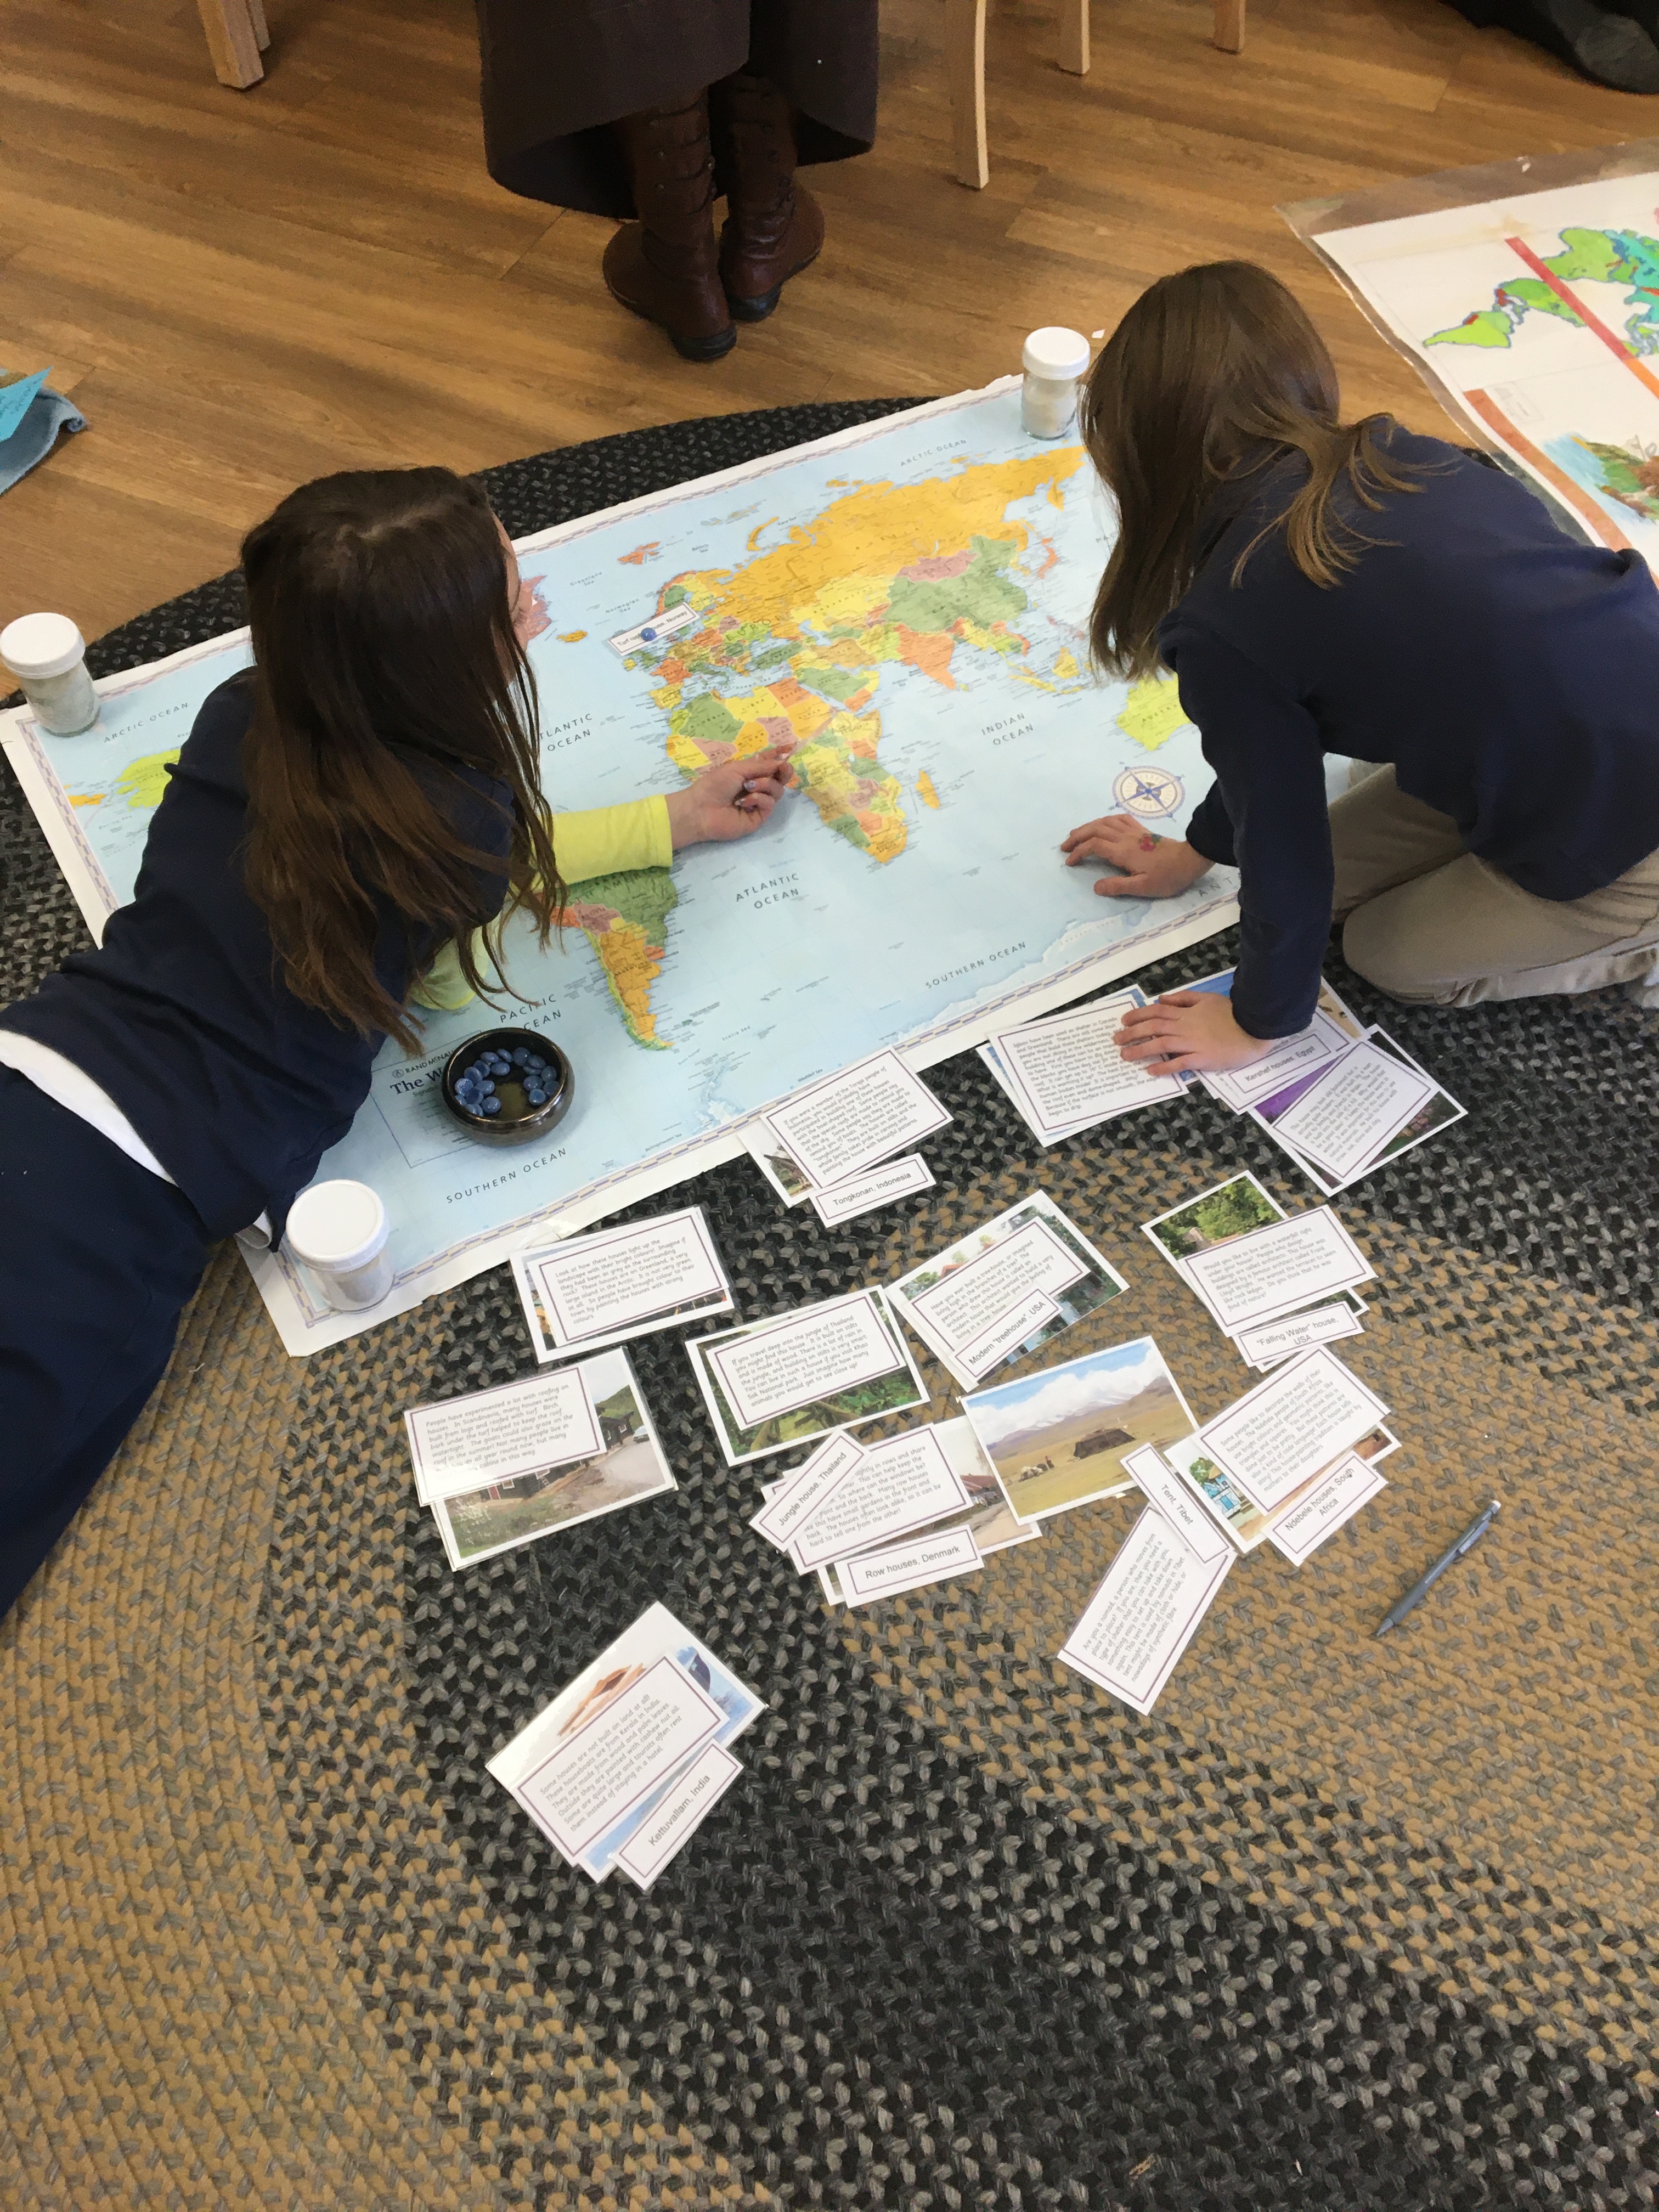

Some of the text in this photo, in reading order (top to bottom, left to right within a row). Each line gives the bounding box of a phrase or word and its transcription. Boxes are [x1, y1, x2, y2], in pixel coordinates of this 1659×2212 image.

[900, 439, 967, 467] ARCTIC OCEAN
[665, 611, 687, 623] Norway
[104, 702, 188, 743] ARCTIC OCEAN
[539, 713, 592, 740] TLANTIC
[981, 713, 1025, 736] INDIAN
[992, 723, 1034, 746] OCEAN
[547, 729, 591, 752] OCEAN
[736, 873, 799, 902] ATLANTIC
[754, 888, 799, 909] OCEAN
[926, 941, 1026, 989] SOUTHERN OCEAN
[500, 994, 556, 1023] PACIIC
[523, 1009, 561, 1030] CEAN
[1294, 1045, 1316, 1058] Egypt
[405, 1062, 427, 1074] RAND
[390, 1077, 425, 1094] The
[446, 1148, 567, 1204] SOUTHERN OCEAN
[832, 1173, 911, 1205] Tongkonan, Indonesia
[555, 1268, 569, 1278] Look
[591, 1257, 607, 1265] these
[607, 1250, 627, 1260] houses
[627, 1245, 641, 1254] light
[930, 1300, 944, 1310] Have
[944, 1294, 954, 1304] you
[953, 1286, 964, 1295] ever
[963, 1278, 977, 1288] built
[980, 1259, 1007, 1277] tree-house,
[1011, 1239, 1034, 1256] imagined
[968, 1343, 995, 1364] Modern
[1028, 1301, 1046, 1314] USA
[1312, 1317, 1339, 1328] house,
[731, 1358, 737, 1367] If
[737, 1355, 749, 1365] you
[749, 1347, 766, 1358] travel
[767, 1343, 781, 1352] deep
[804, 1328, 822, 1339] jungle
[822, 1323, 830, 1331] of
[829, 1314, 854, 1328] Thailand
[1293, 1334, 1313, 1345] USA
[425, 1418, 446, 1427] People
[464, 1400, 505, 1417] experimented
[522, 1392, 536, 1401] with
[538, 1386, 560, 1396] roofing
[1220, 1435, 1234, 1447] Some
[1234, 1423, 1250, 1438] people
[1248, 1416, 1259, 1424] like
[1264, 1396, 1284, 1413] decorate
[1292, 1381, 1305, 1392] walls
[1304, 1375, 1312, 1384] of
[1309, 1368, 1321, 1379] their
[778, 1452, 847, 1526] Jungle house, Thailand
[1161, 1483, 1193, 1525] Tent, Tibet
[1284, 1468, 1355, 1531] Ndebele houses, South
[1319, 1498, 1339, 1516] Africa
[809, 1537, 825, 1548] hard
[833, 1530, 844, 1538] tell
[844, 1526, 856, 1534] one
[856, 1520, 872, 1531] from
[883, 1507, 901, 1519] other!
[865, 1545, 960, 1579] Row houses, Denmark
[1082, 1639, 1092, 1650] Are
[1090, 1627, 1099, 1641] you
[1100, 1601, 1116, 1622] nomad,
[1116, 1576, 1130, 1596] person
[1127, 1564, 1137, 1576] who
[1135, 1545, 1148, 1563] moves
[1144, 1533, 1156, 1547] from
[539, 1694, 650, 1795] Some houses are not built on land at all!
[648, 1775, 710, 1846] Kettuvallam, India
